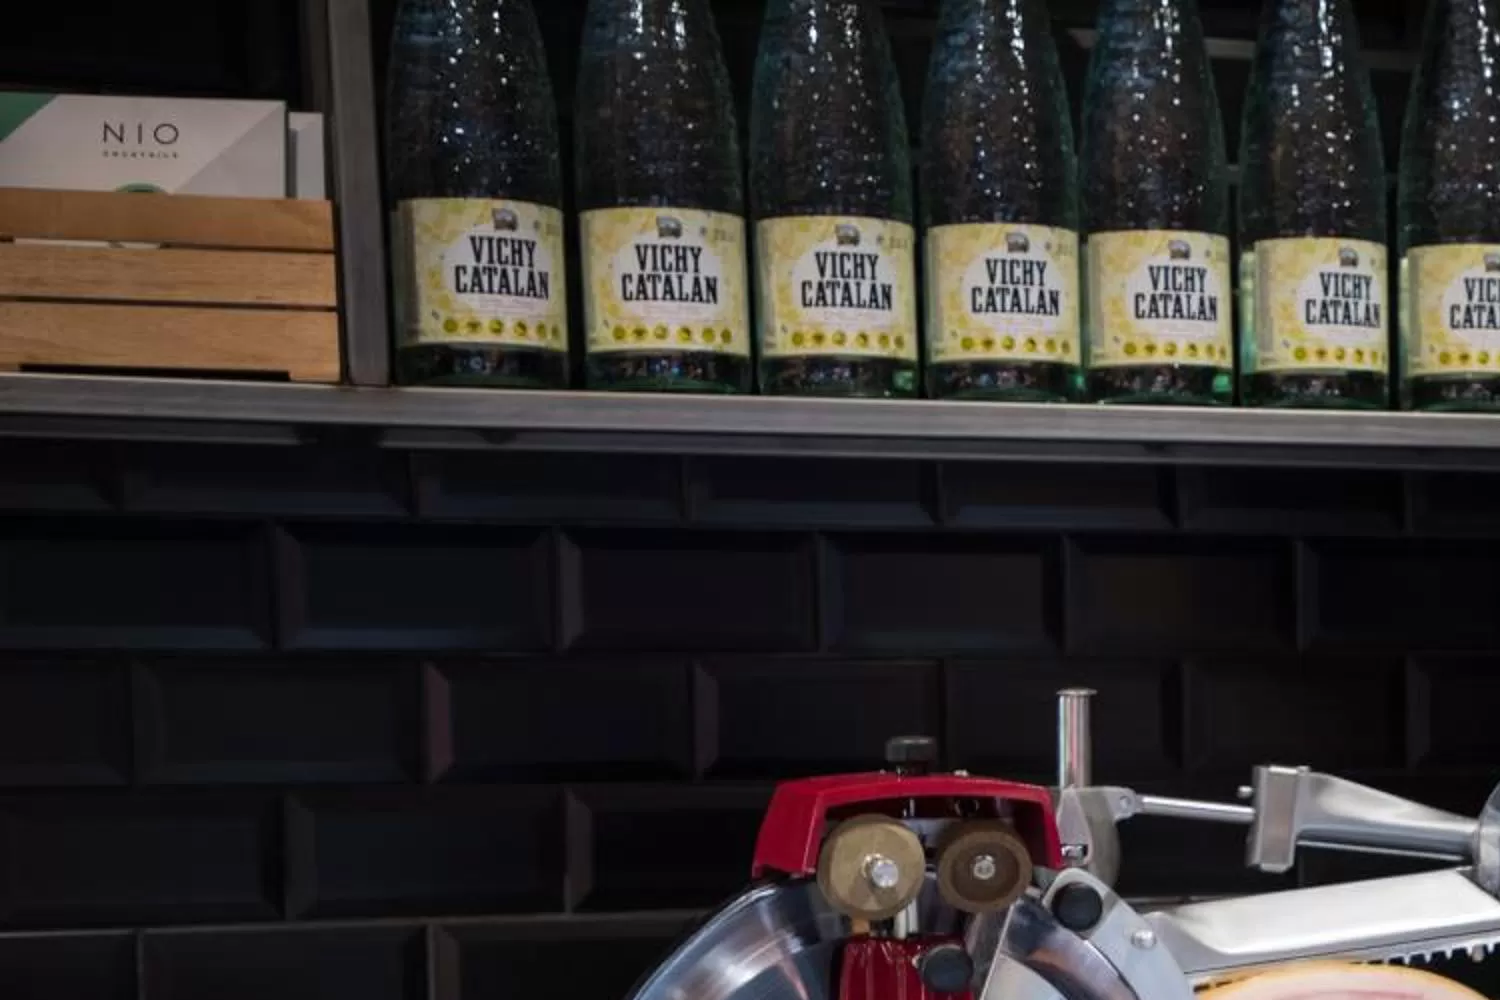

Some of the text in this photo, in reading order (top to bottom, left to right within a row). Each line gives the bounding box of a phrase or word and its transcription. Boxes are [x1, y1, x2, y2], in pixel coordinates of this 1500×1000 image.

[102, 121, 180, 145] NIO
[469, 235, 537, 267] VICHY
[634, 243, 703, 273] VICHY
[815, 251, 879, 280] VICHY
[454, 265, 550, 300] CATALAN
[985, 258, 1048, 286] VICHY
[1148, 265, 1207, 293] VICHY
[1319, 272, 1373, 299] VICHY
[621, 273, 718, 304] CATALAN
[801, 280, 893, 310] CATALAN
[971, 286, 1061, 316] CATALAN
[1134, 292, 1218, 322] CATALAN
[1305, 298, 1381, 329] CATALAN
